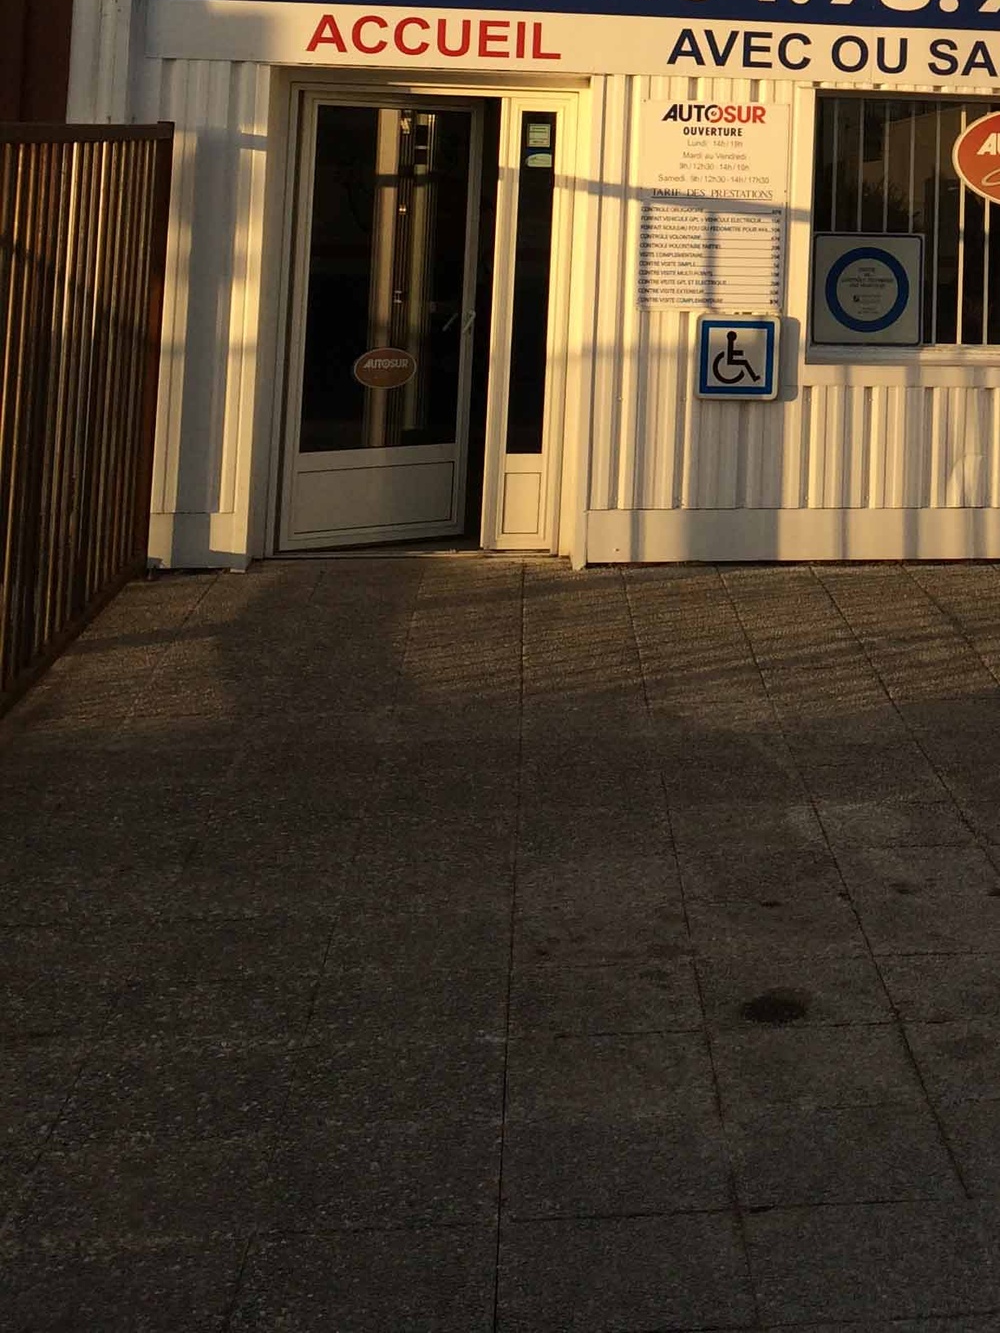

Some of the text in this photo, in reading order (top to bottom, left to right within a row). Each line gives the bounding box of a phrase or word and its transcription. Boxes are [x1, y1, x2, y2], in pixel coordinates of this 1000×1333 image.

[305, 13, 562, 61] ACCUEIL
[666, 27, 812, 71] AVEC
[830, 34, 909, 74] OU
[661, 103, 767, 125] AUTOSUR
[683, 126, 743, 137] OUVERTURE
[652, 188, 774, 199] TARIF DES PRESTATIONS
[363, 358, 409, 369] AUTOSUR
